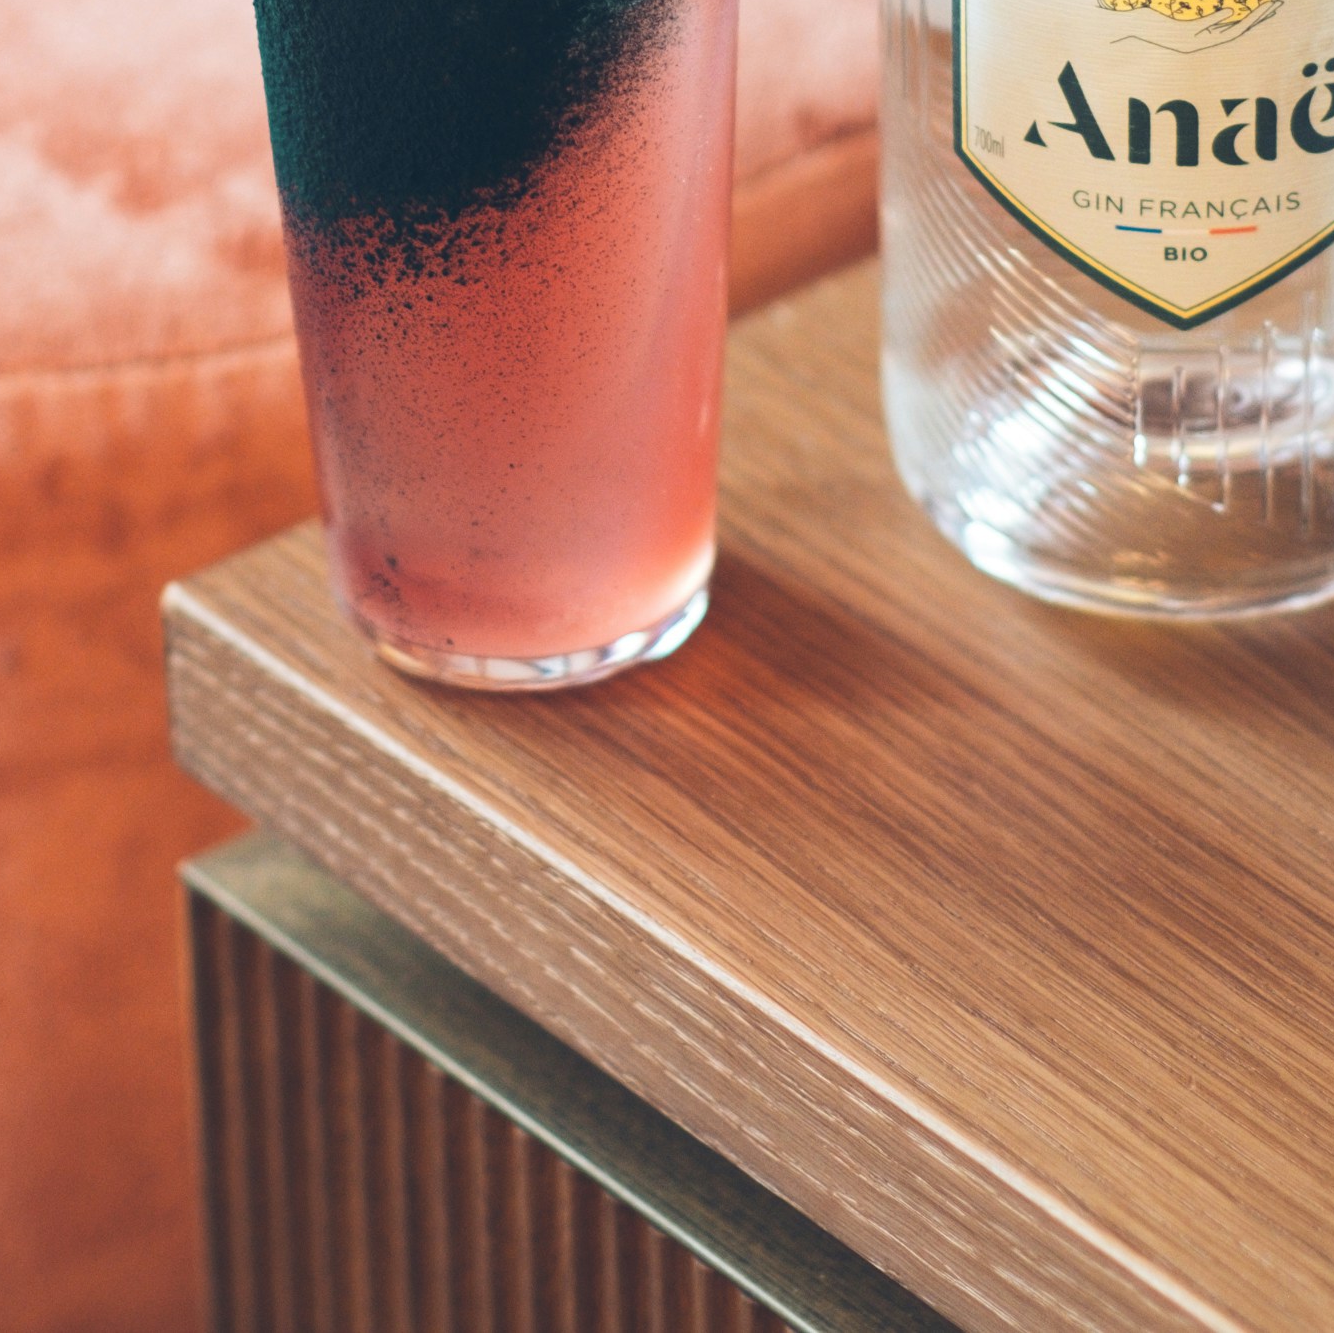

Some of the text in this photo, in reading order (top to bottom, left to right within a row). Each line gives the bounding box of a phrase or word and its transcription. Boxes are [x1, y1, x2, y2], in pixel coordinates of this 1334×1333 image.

[1072, 190, 1302, 220] GIN FRANÇAIS
[1163, 245, 1208, 263] BIO
